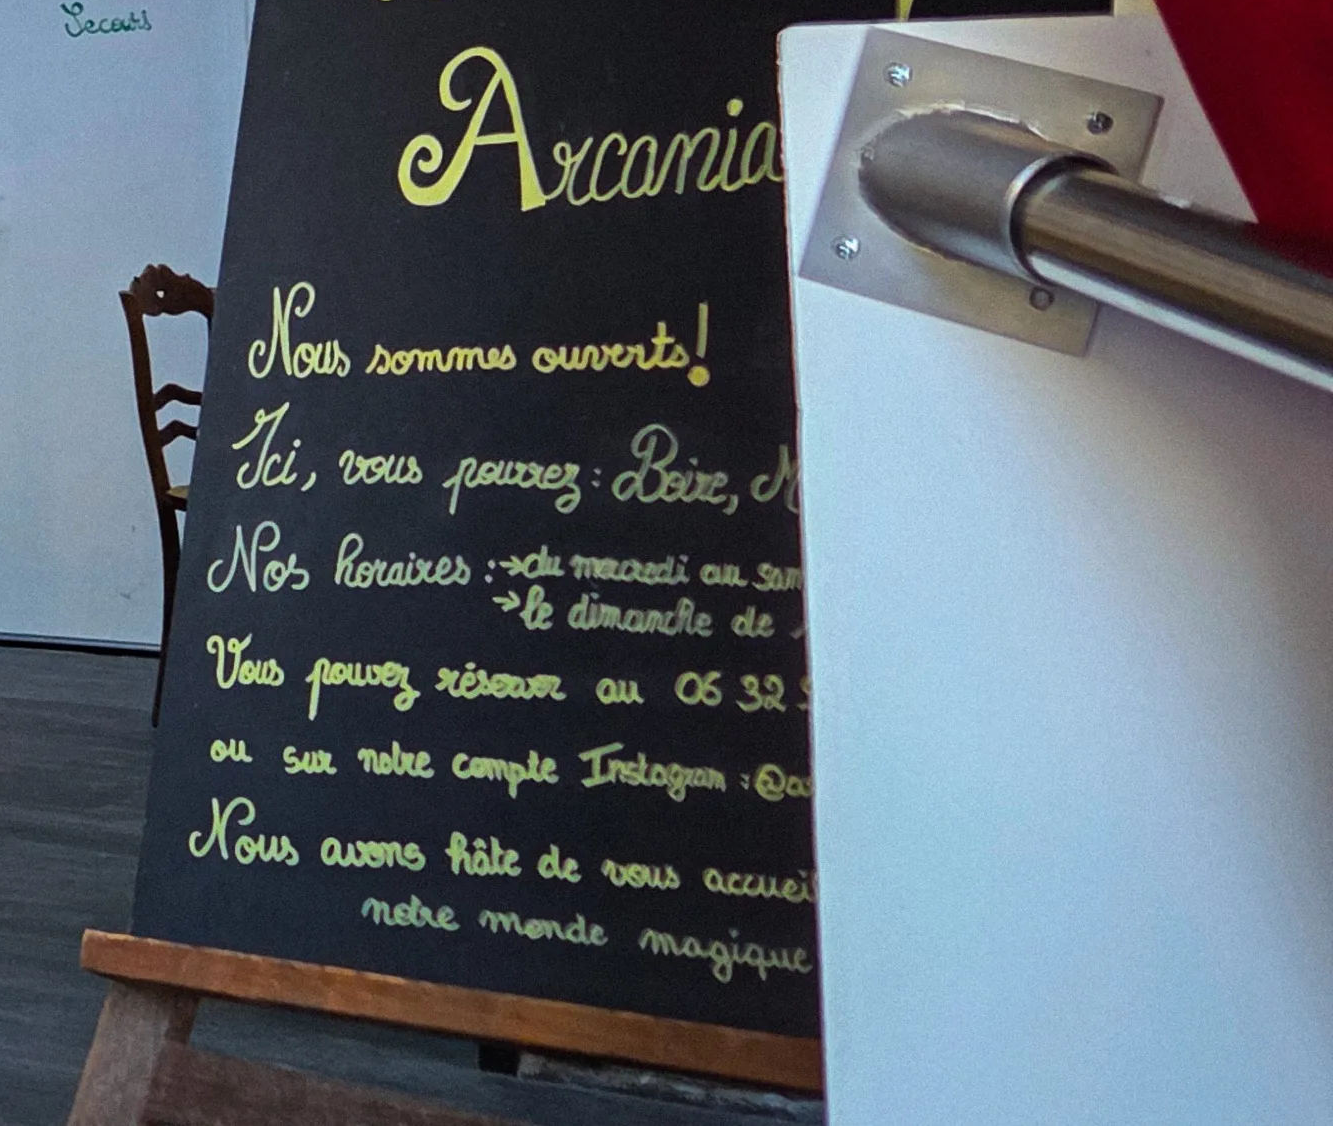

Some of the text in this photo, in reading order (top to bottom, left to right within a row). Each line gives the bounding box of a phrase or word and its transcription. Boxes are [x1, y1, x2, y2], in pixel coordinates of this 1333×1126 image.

[398, 45, 784, 212] Arcania
[248, 281, 351, 380] Nous
[366, 342, 518, 375] sommes
[232, 402, 424, 493] Ici, vous
[207, 520, 472, 595] Nos horaires
[569, 592, 776, 639] dimanche de
[206, 633, 786, 720] Vous pouvez réserver au 06 32
[209, 739, 727, 802] ou sur notre compte Instagram
[188, 797, 681, 888] Nous avons hâte de vous
[361, 895, 814, 984] notre monde magique
